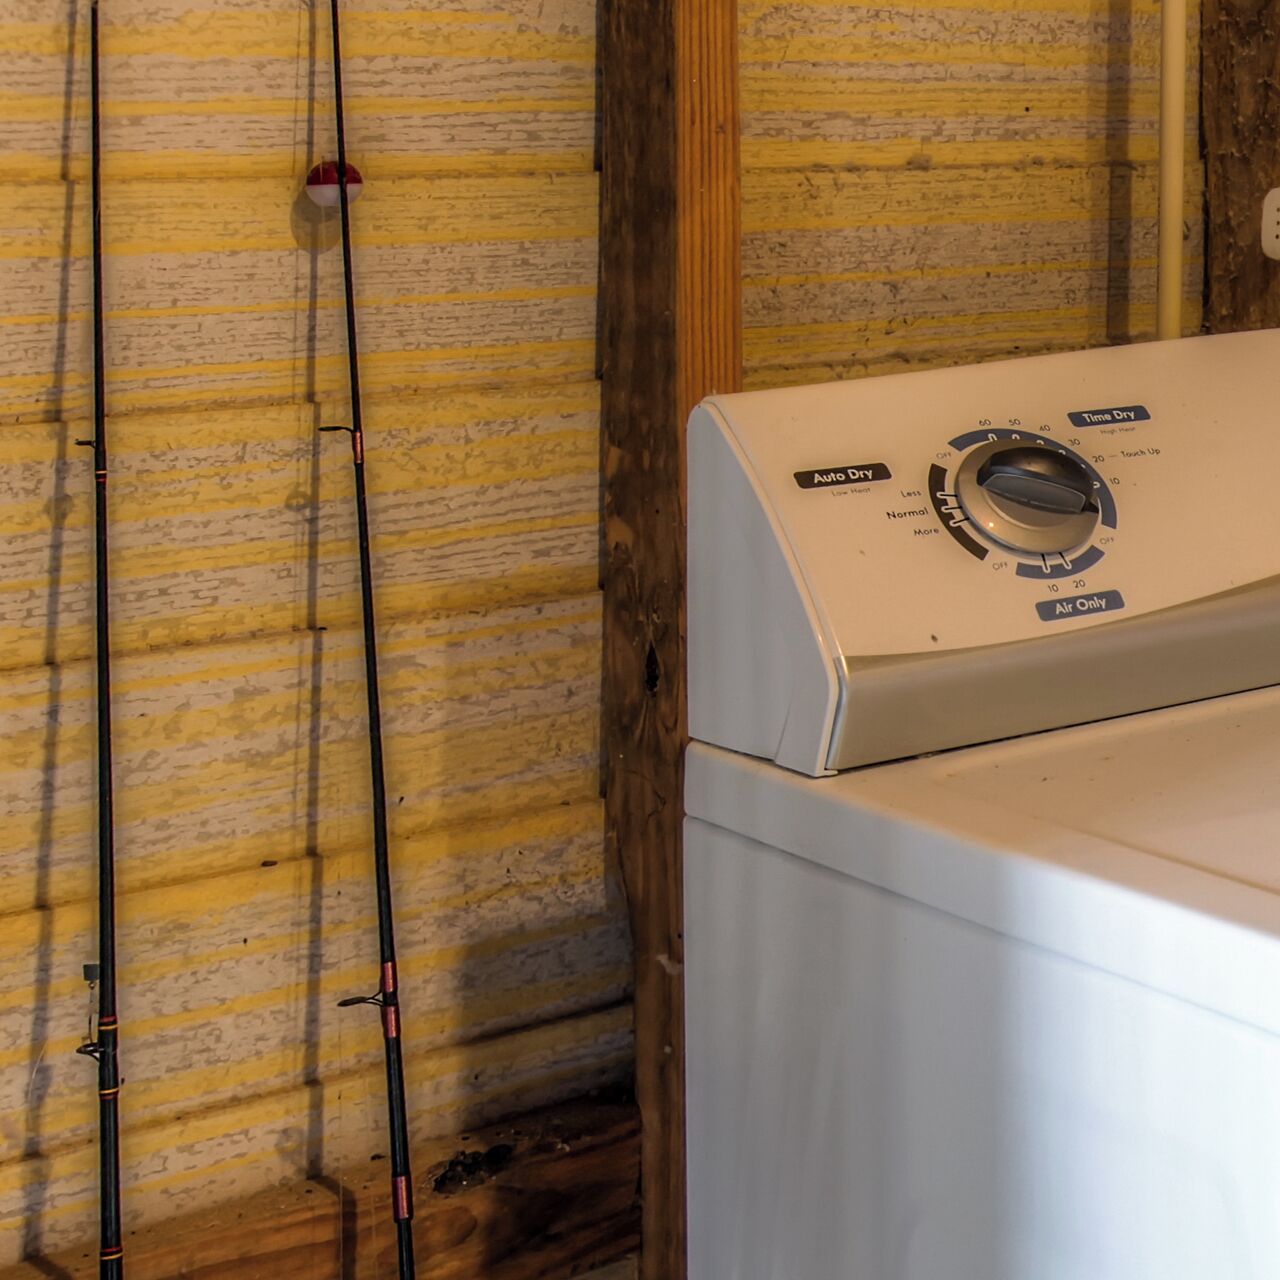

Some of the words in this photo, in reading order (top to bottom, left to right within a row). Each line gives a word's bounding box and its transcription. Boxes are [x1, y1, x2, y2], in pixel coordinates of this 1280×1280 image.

[1082, 412, 1112, 424] Time
[1113, 410, 1136, 421] Dry
[979, 418, 991, 427] 60
[1009, 418, 1021, 427] 50
[1039, 424, 1051, 432] 40
[1068, 438, 1081, 447] 30
[1093, 455, 1105, 463] 20
[1121, 449, 1146, 459] Touch
[1147, 447, 1161, 457] Up
[814, 470, 846, 484] Auto
[847, 468, 873, 481] Dry
[1109, 477, 1121, 486] 10
[832, 489, 848, 498] Low
[850, 486, 872, 495] Heat
[901, 489, 922, 499] Less
[886, 506, 929, 520] Normal
[913, 527, 939, 537] More
[1048, 583, 1059, 593] 10
[1073, 579, 1086, 589] 20
[1055, 601, 1073, 615] Air
[1076, 596, 1106, 611] Only
